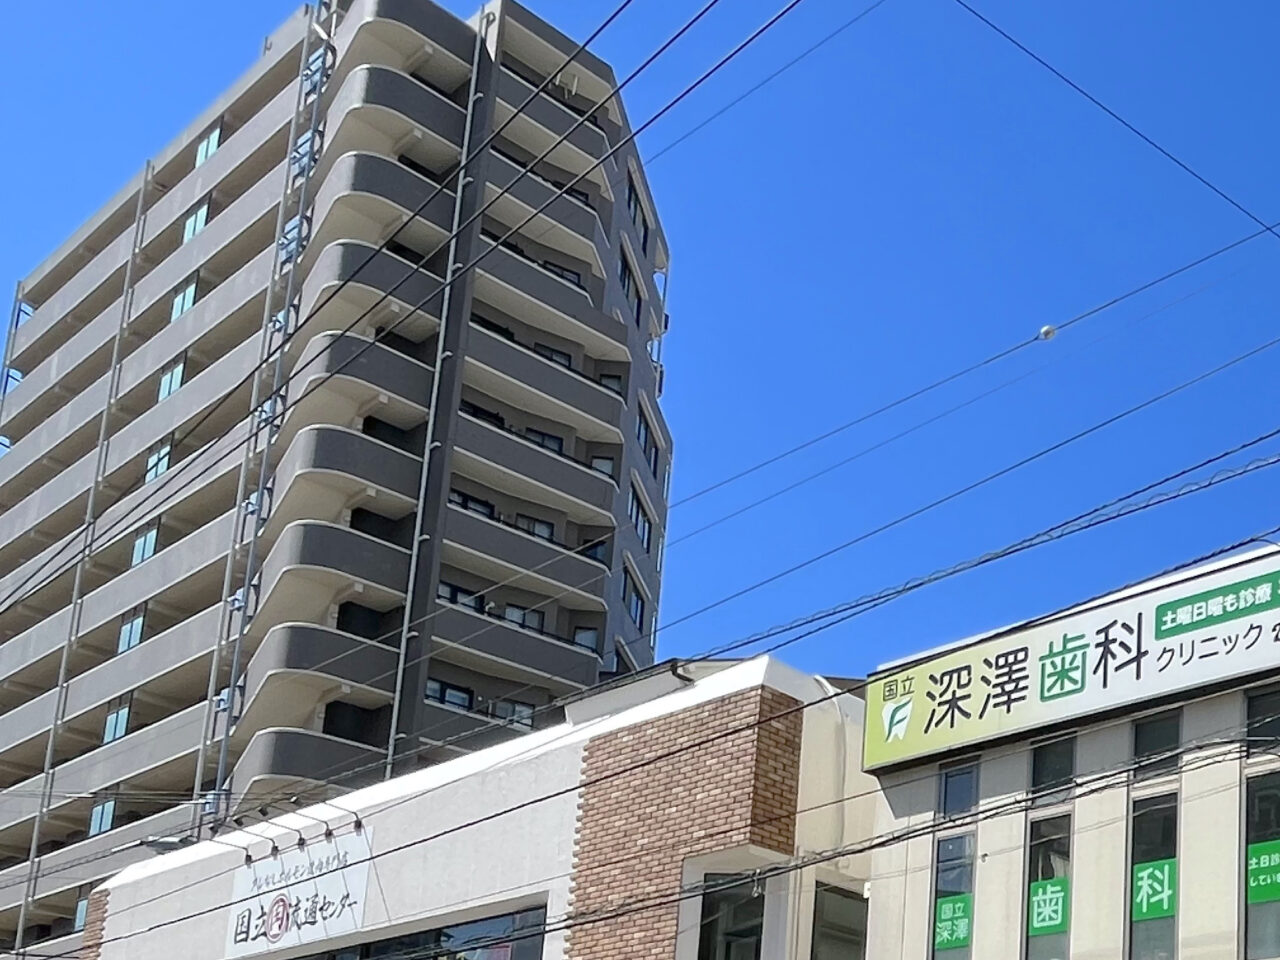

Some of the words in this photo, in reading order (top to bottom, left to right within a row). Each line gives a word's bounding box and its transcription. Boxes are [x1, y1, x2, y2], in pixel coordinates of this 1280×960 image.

[1161, 583, 1273, 631] 土曜日曜も診療
[1157, 623, 1263, 673] クリニック
[883, 675, 915, 701] 国立
[923, 612, 1149, 734] 深澤歯科
[941, 902, 965, 919] 国立
[1032, 884, 1064, 928] 歯
[1136, 864, 1173, 913] 科
[936, 918, 969, 943] 深澤
